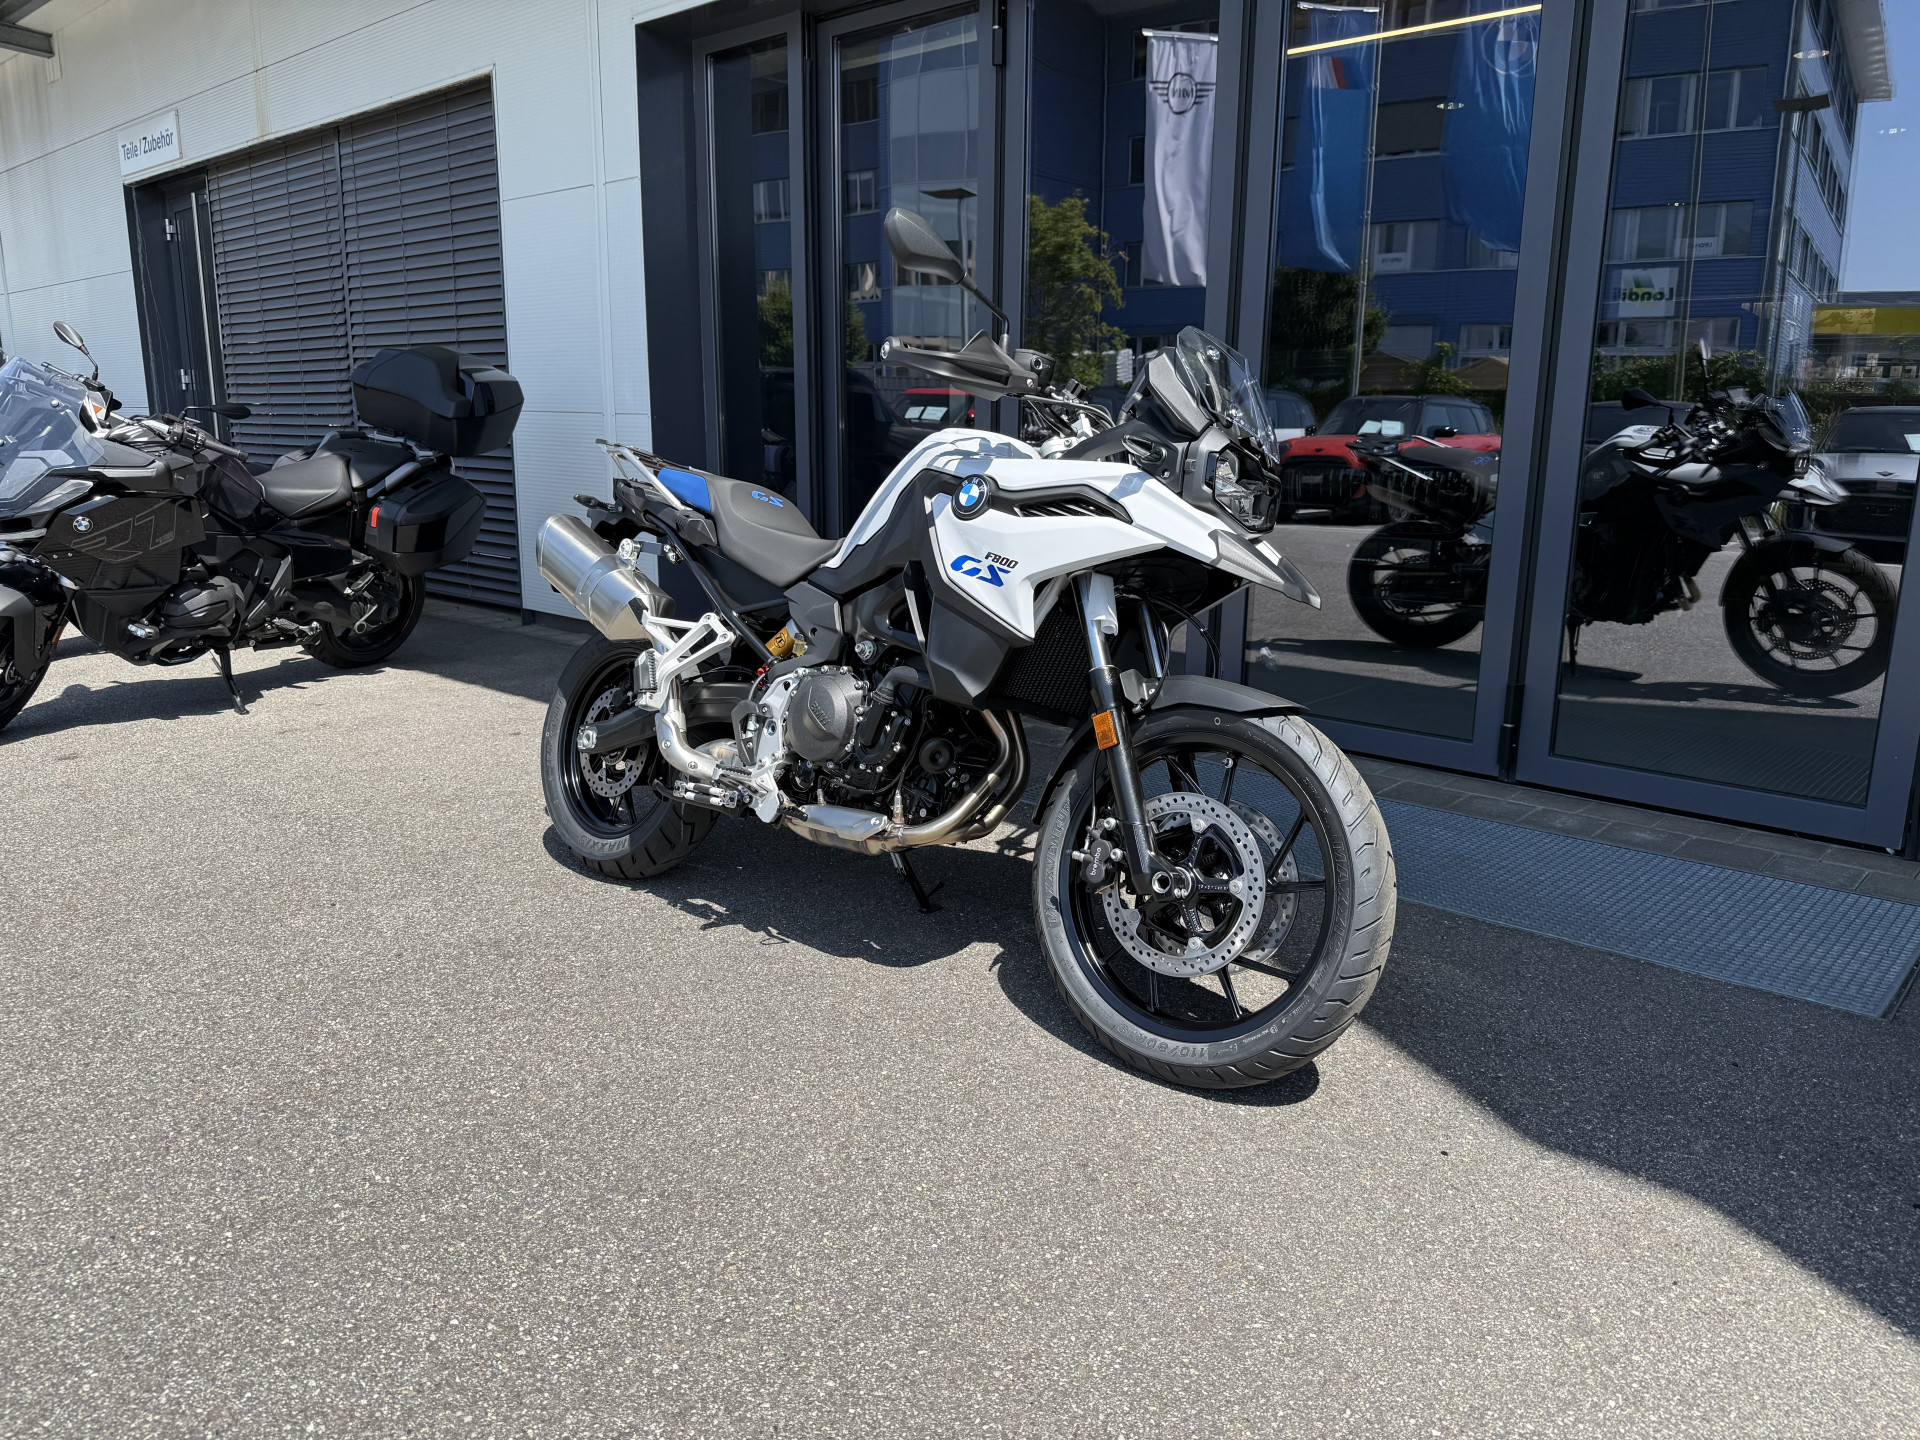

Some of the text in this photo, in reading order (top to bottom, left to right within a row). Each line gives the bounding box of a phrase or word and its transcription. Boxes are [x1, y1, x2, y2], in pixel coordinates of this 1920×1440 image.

[121, 141, 138, 160] Teile
[142, 128, 174, 155] Zubehör
[962, 477, 985, 492] BMW
[752, 490, 783, 508] GS
[950, 554, 1012, 587] GS
[984, 551, 1019, 570] F800
[1090, 847, 1102, 876] brembo
